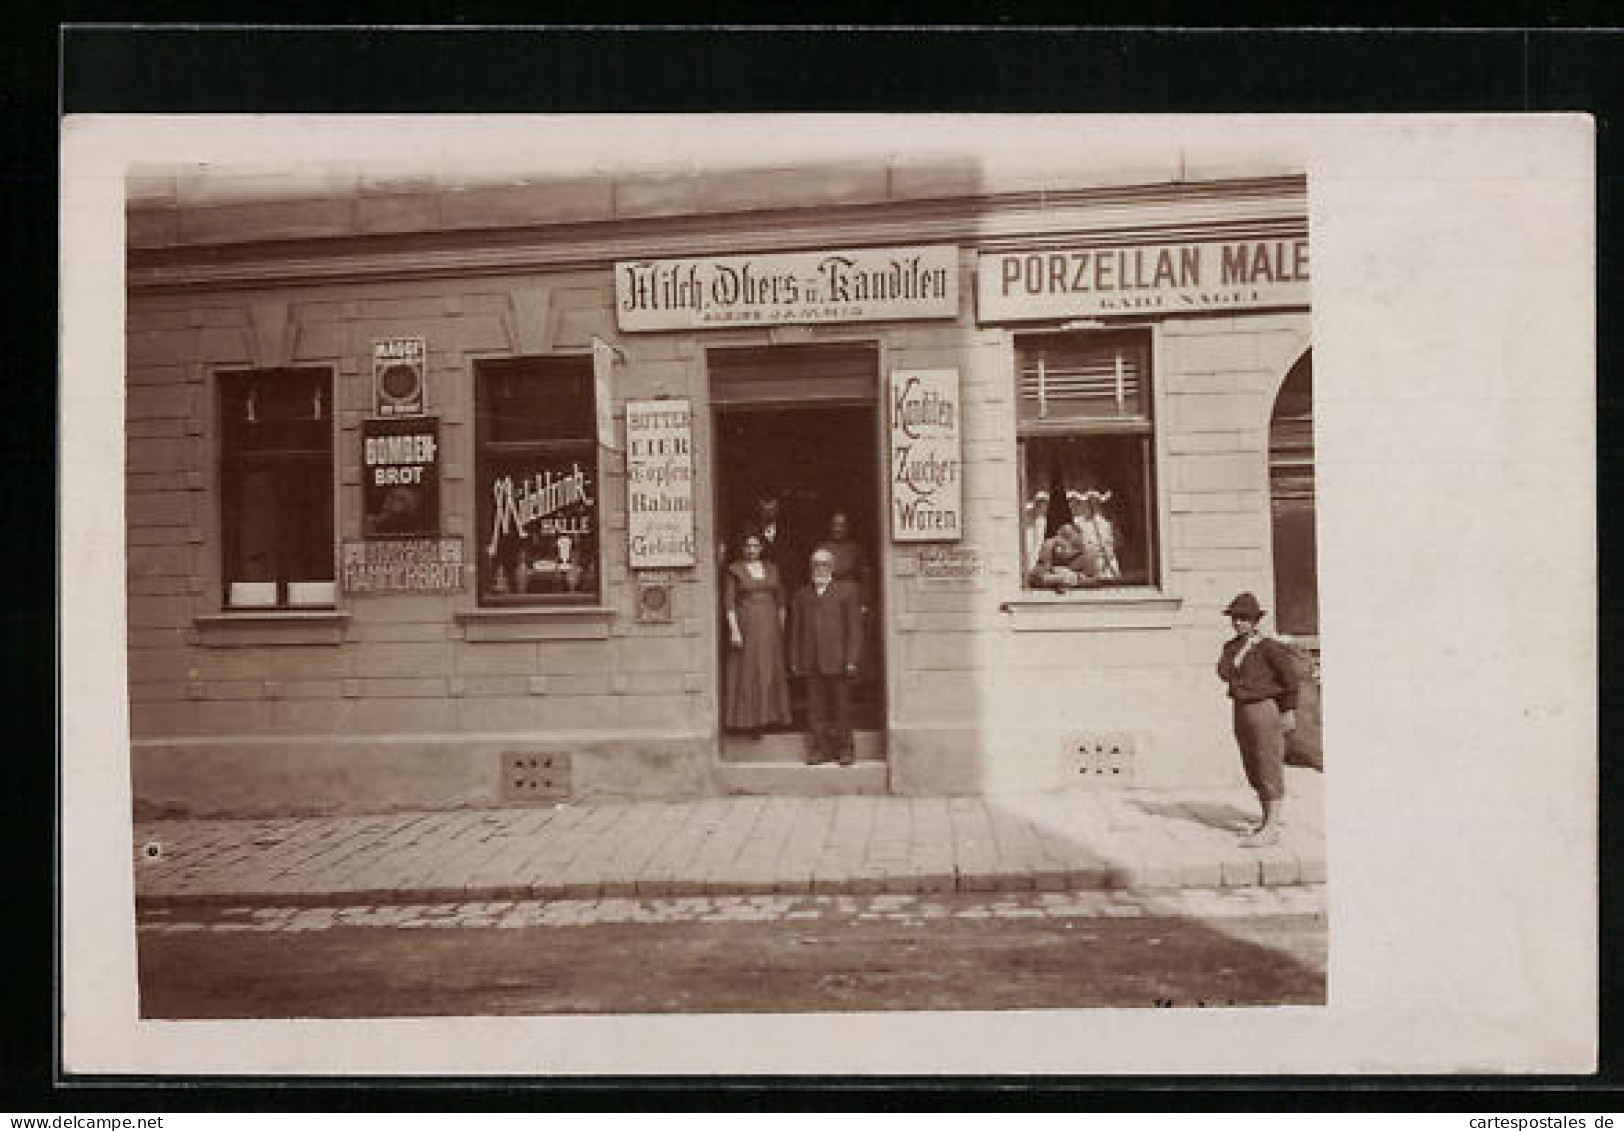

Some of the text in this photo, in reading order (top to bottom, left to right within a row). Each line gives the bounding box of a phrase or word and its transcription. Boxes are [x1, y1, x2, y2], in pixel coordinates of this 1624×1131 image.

[1002, 247, 1200, 297] PORZELLAN
[375, 466, 424, 487] BROT
[540, 516, 591, 534] HALLE
